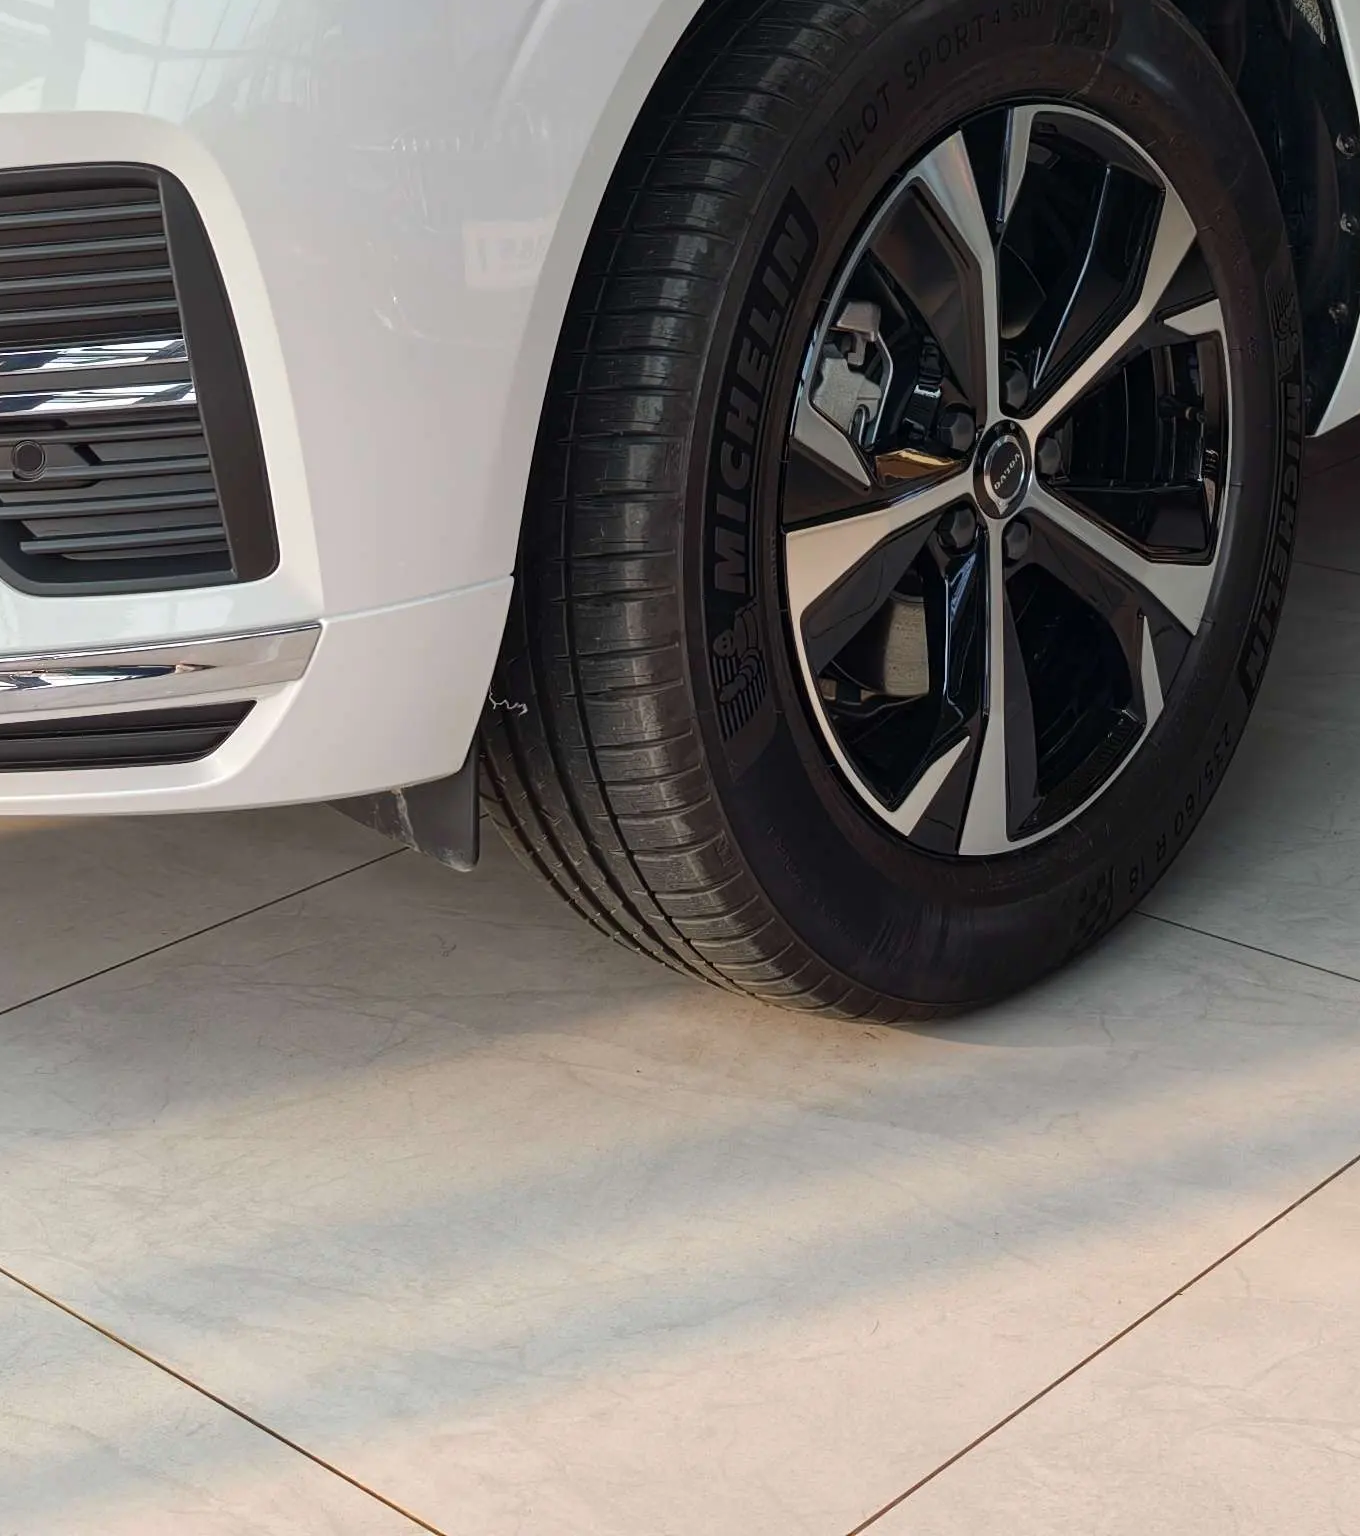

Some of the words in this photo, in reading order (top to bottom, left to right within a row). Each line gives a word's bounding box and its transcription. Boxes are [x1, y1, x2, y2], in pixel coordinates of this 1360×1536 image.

[824, 79, 892, 188] PILOT
[902, 12, 988, 92] SPORT
[714, 214, 810, 594] MICHELIN
